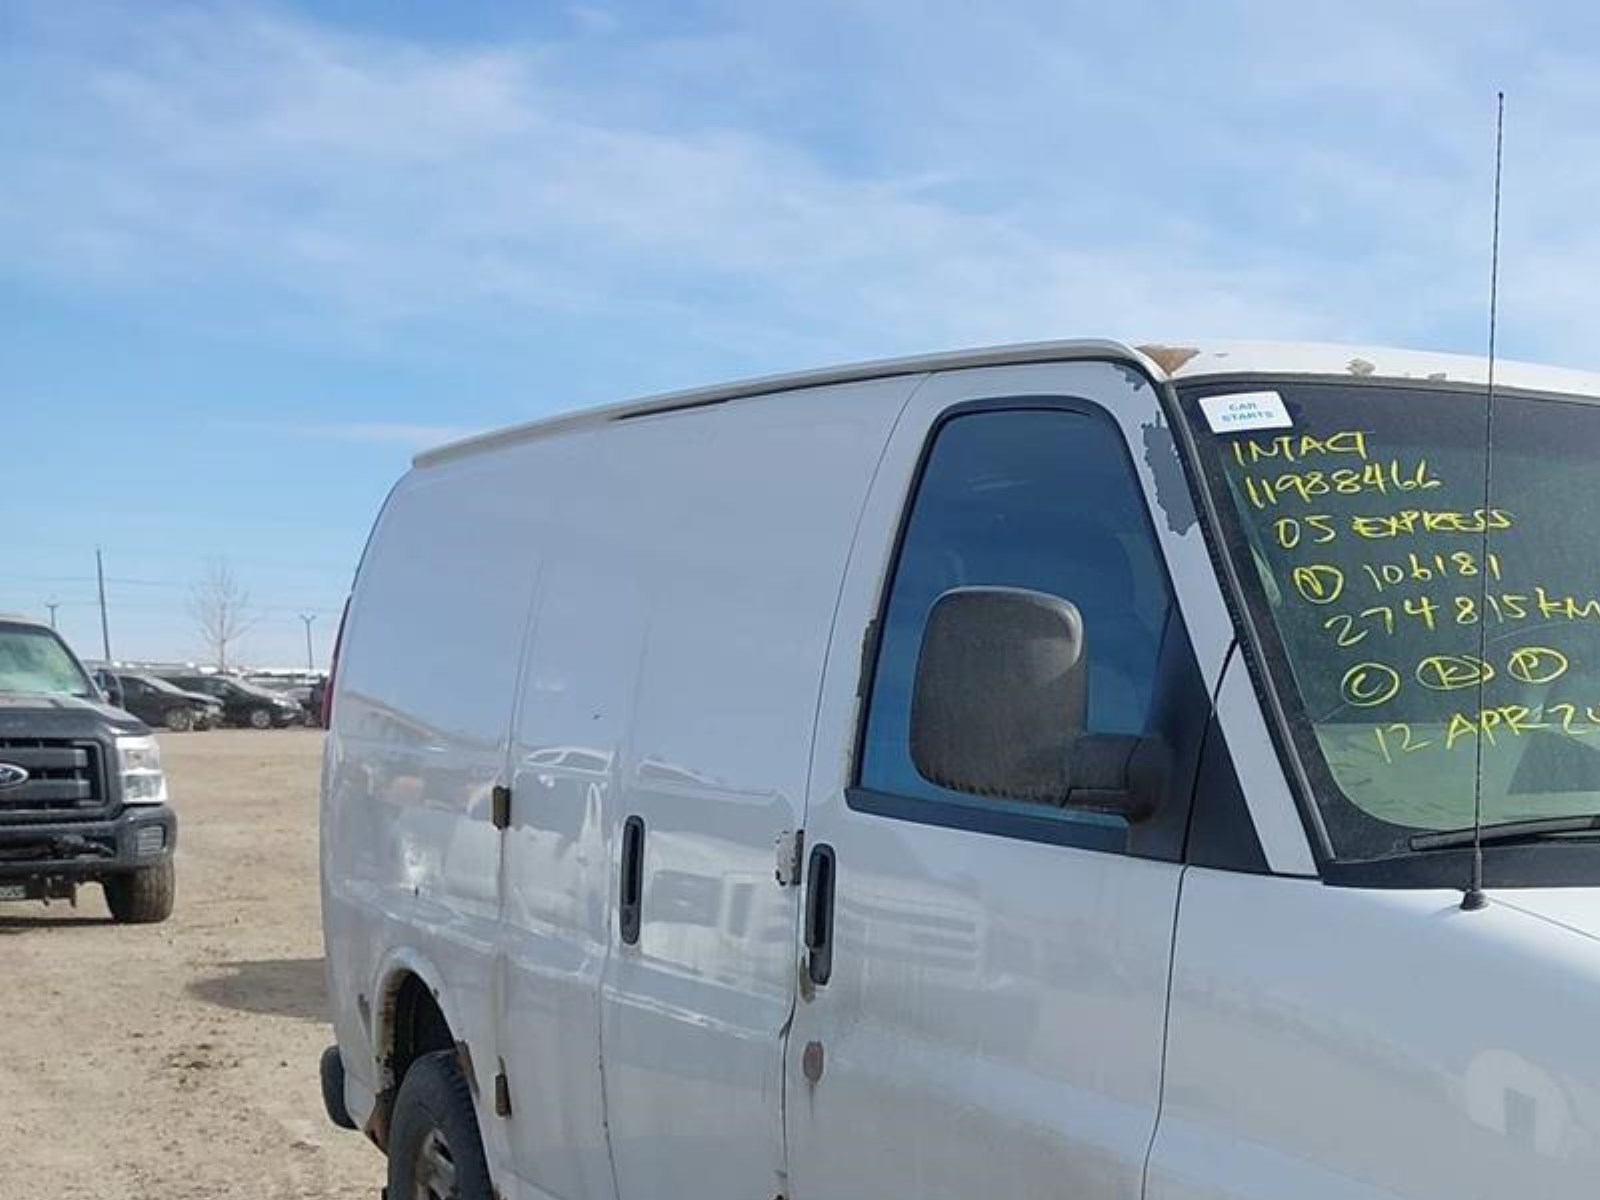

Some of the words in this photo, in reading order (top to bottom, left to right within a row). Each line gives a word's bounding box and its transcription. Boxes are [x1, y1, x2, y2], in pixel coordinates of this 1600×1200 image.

[1245, 459, 1442, 510] 11988466
[1352, 508, 1512, 538] EXPRESS
[1362, 551, 1502, 593] 106181
[1374, 712, 1433, 763] 12
[1446, 704, 1548, 751] APR
